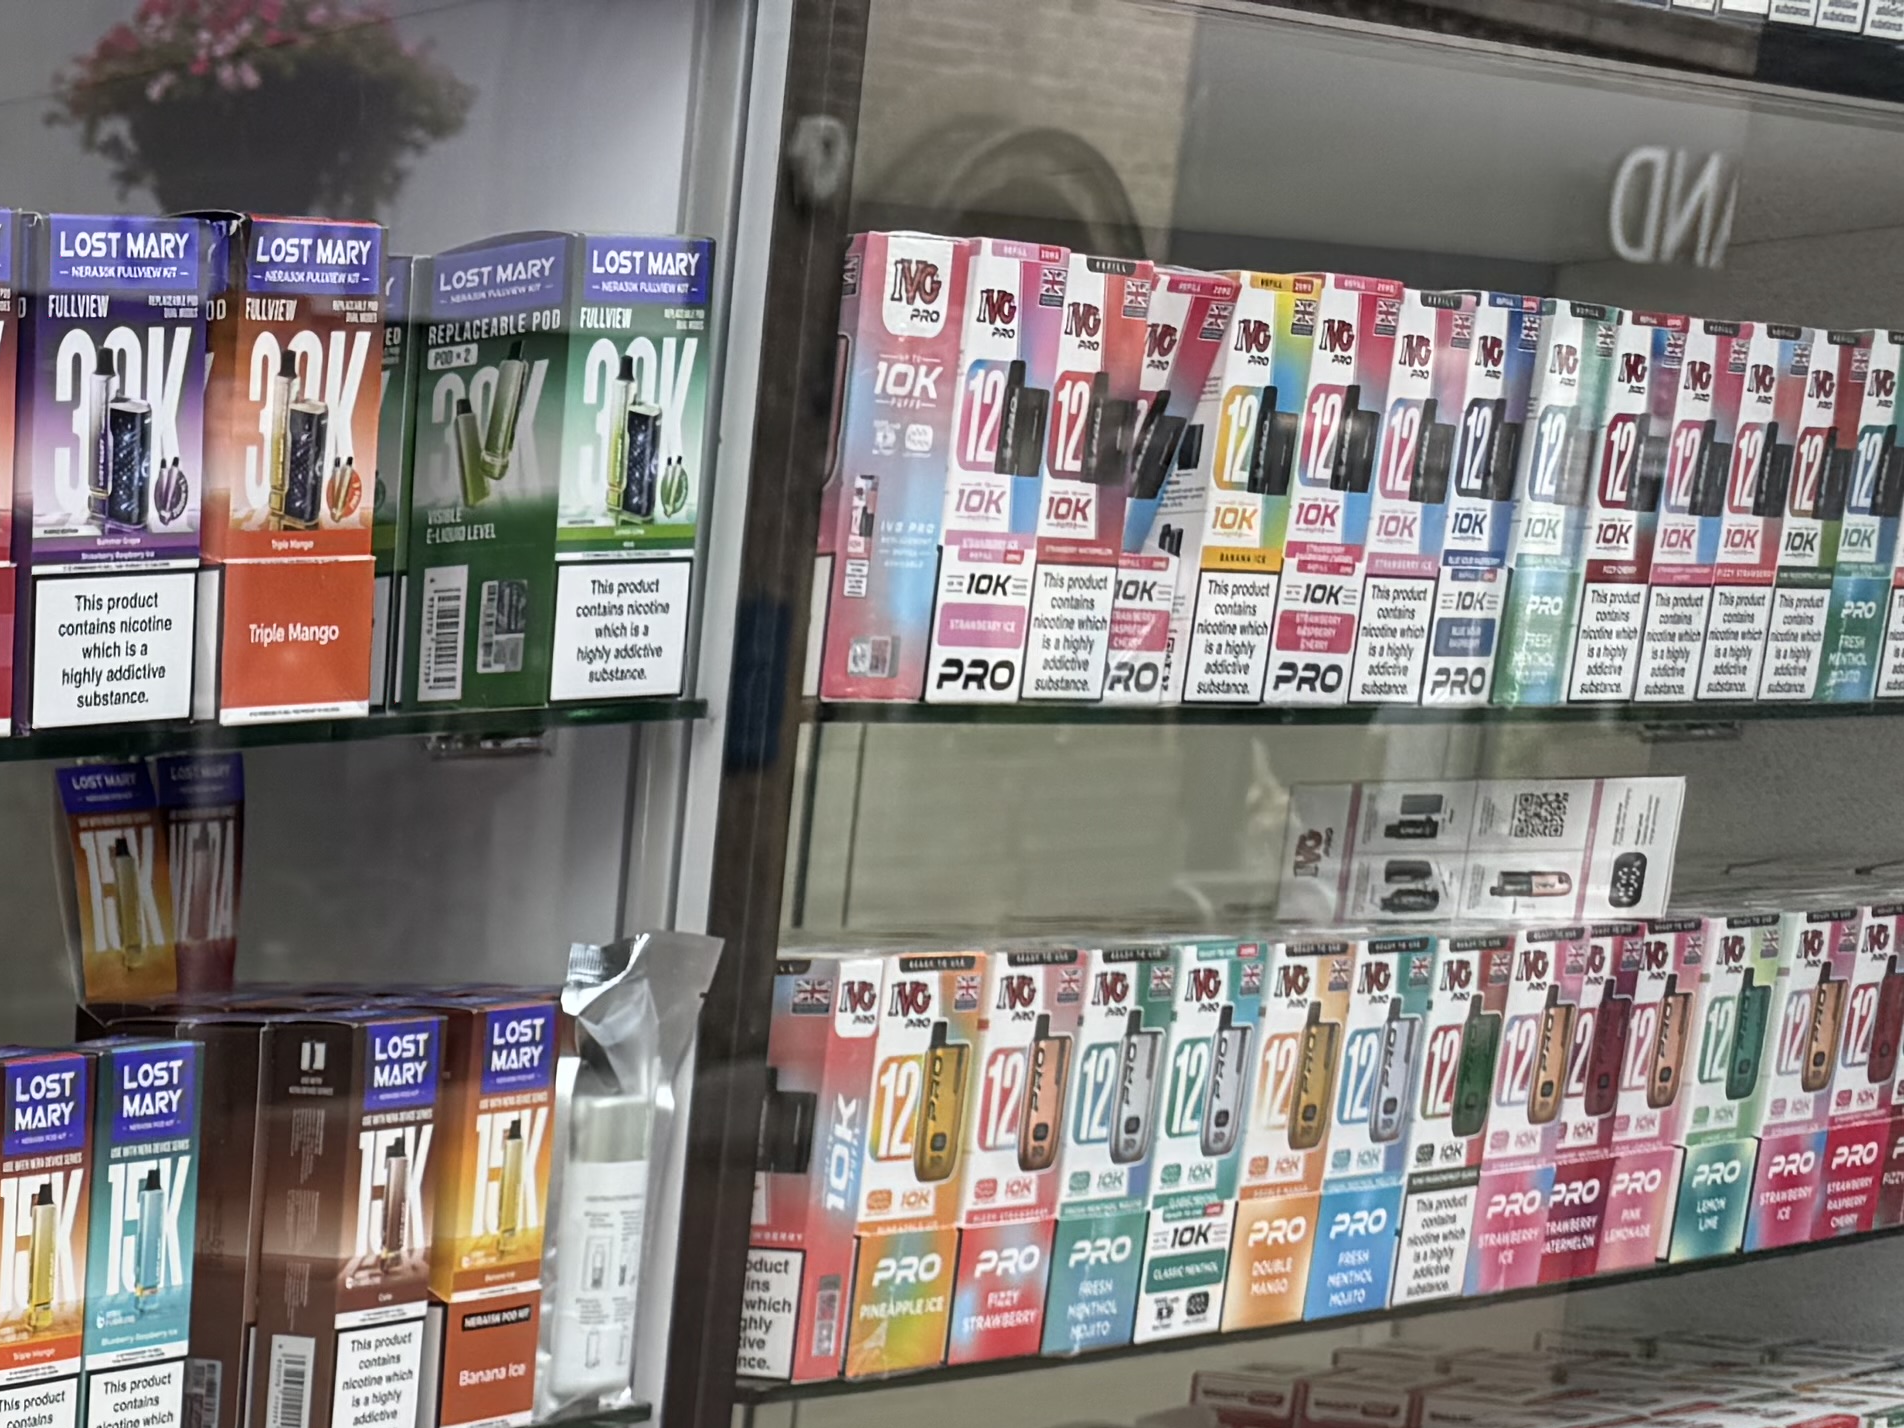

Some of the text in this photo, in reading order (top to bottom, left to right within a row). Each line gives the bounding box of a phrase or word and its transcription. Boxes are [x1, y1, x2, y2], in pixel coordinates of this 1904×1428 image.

[60, 231, 188, 258] LOST MARY
[428, 309, 560, 344] REPLACEABLE POD
[1046, 496, 1092, 522] 10K
[1044, 572, 1108, 592] This product
[1051, 595, 1095, 610] contains
[250, 623, 339, 647] Triple Mango
[937, 659, 1014, 690] PRO
[375, 1033, 428, 1060] LOST
[374, 1061, 427, 1087] MARY
[873, 1254, 941, 1286] PRO
[459, 1364, 526, 1386] Banana Ice
